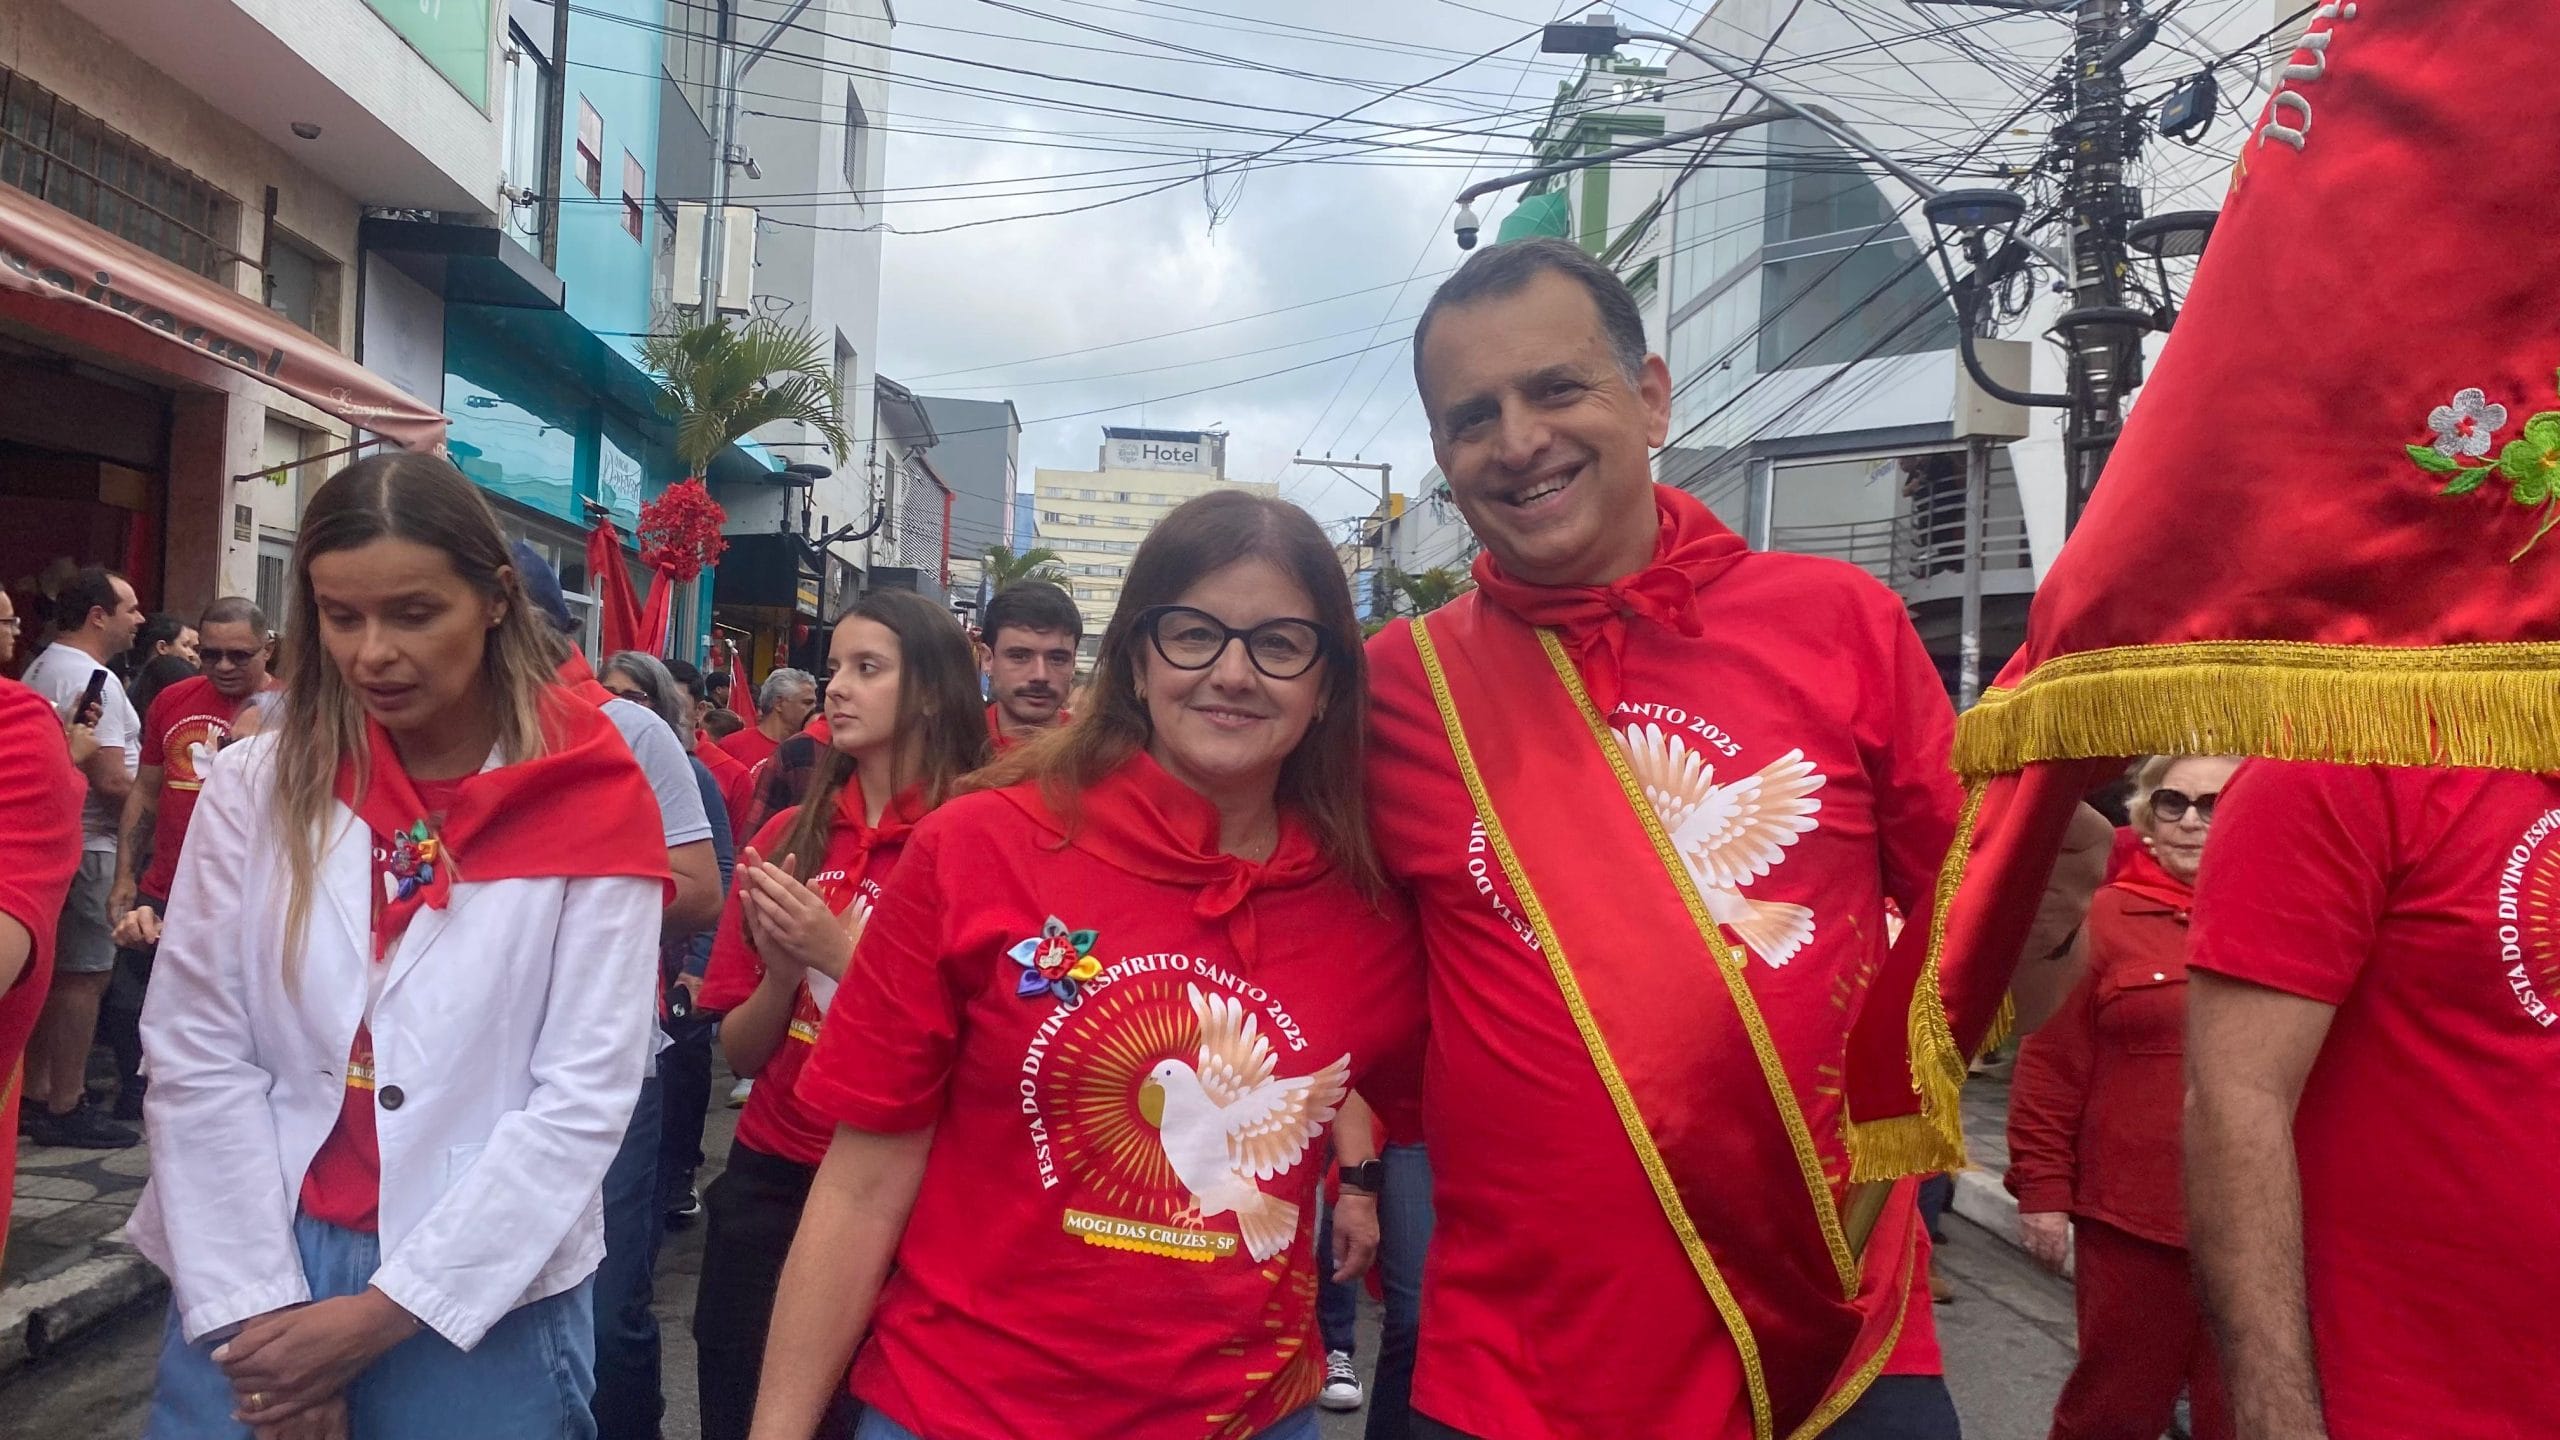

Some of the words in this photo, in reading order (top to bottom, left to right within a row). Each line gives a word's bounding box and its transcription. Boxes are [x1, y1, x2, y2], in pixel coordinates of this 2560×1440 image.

[1143, 444, 1198, 462] Hotel
[1468, 858, 1493, 895] DO
[1614, 701, 1687, 724] ANTO
[1687, 716, 1743, 757] 2025
[2498, 845, 2531, 920] DIVINO
[2499, 925, 2521, 962] DO
[1082, 953, 1189, 997] ESPÍRITO
[1193, 957, 1268, 1003] SANTO
[2506, 963, 2559, 1028] FESTA
[1266, 1000, 1308, 1052] 2025
[1020, 1079, 1040, 1114] DO
[1028, 1118, 1059, 1190] FESTA
[1066, 1215, 1112, 1234] MOGI
[1115, 1223, 1146, 1239] DAS
[1150, 1228, 1207, 1248] CRUZES
[1216, 1236, 1236, 1250] SP
